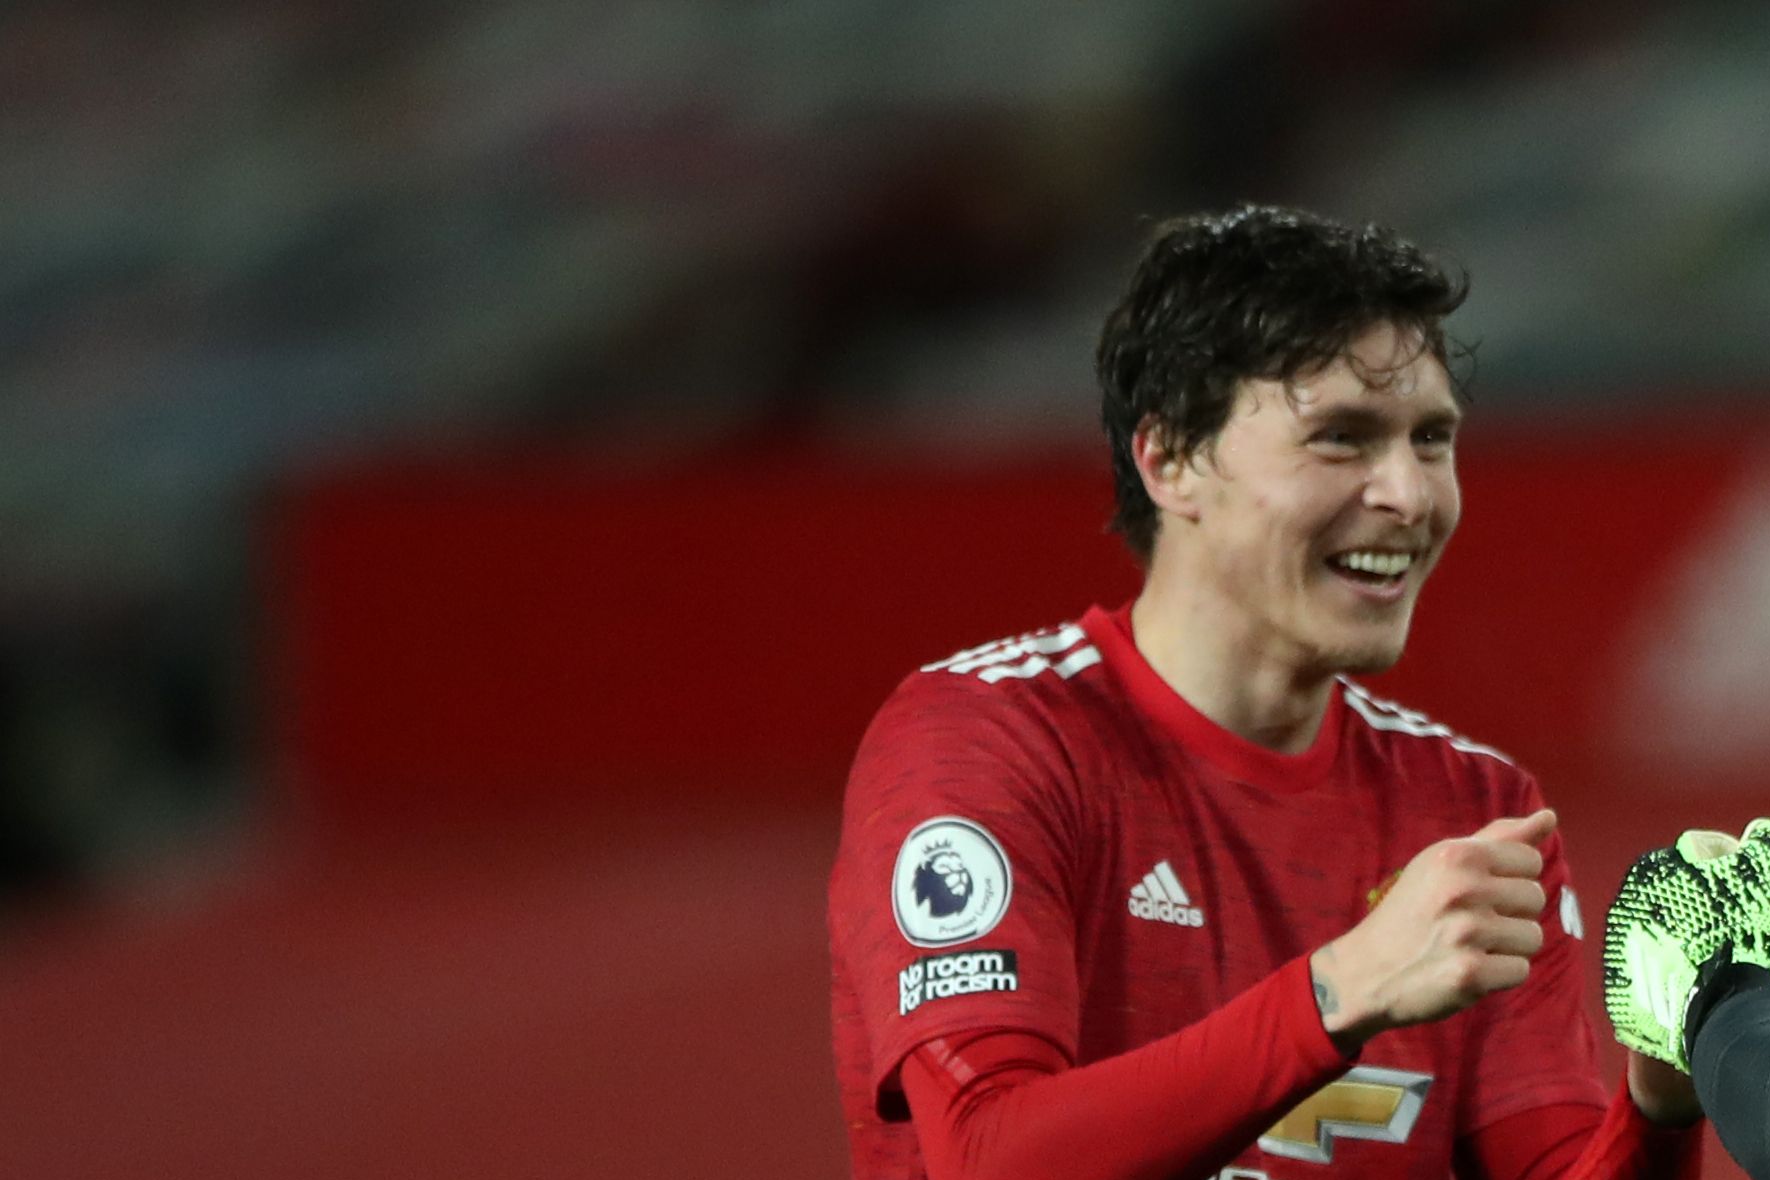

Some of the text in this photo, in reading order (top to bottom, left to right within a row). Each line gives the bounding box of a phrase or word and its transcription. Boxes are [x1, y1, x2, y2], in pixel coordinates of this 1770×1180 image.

[938, 915, 977, 935] Premier
[1127, 897, 1205, 928] adidas
[899, 951, 1004, 990] No room
[925, 971, 1017, 1000] racism
